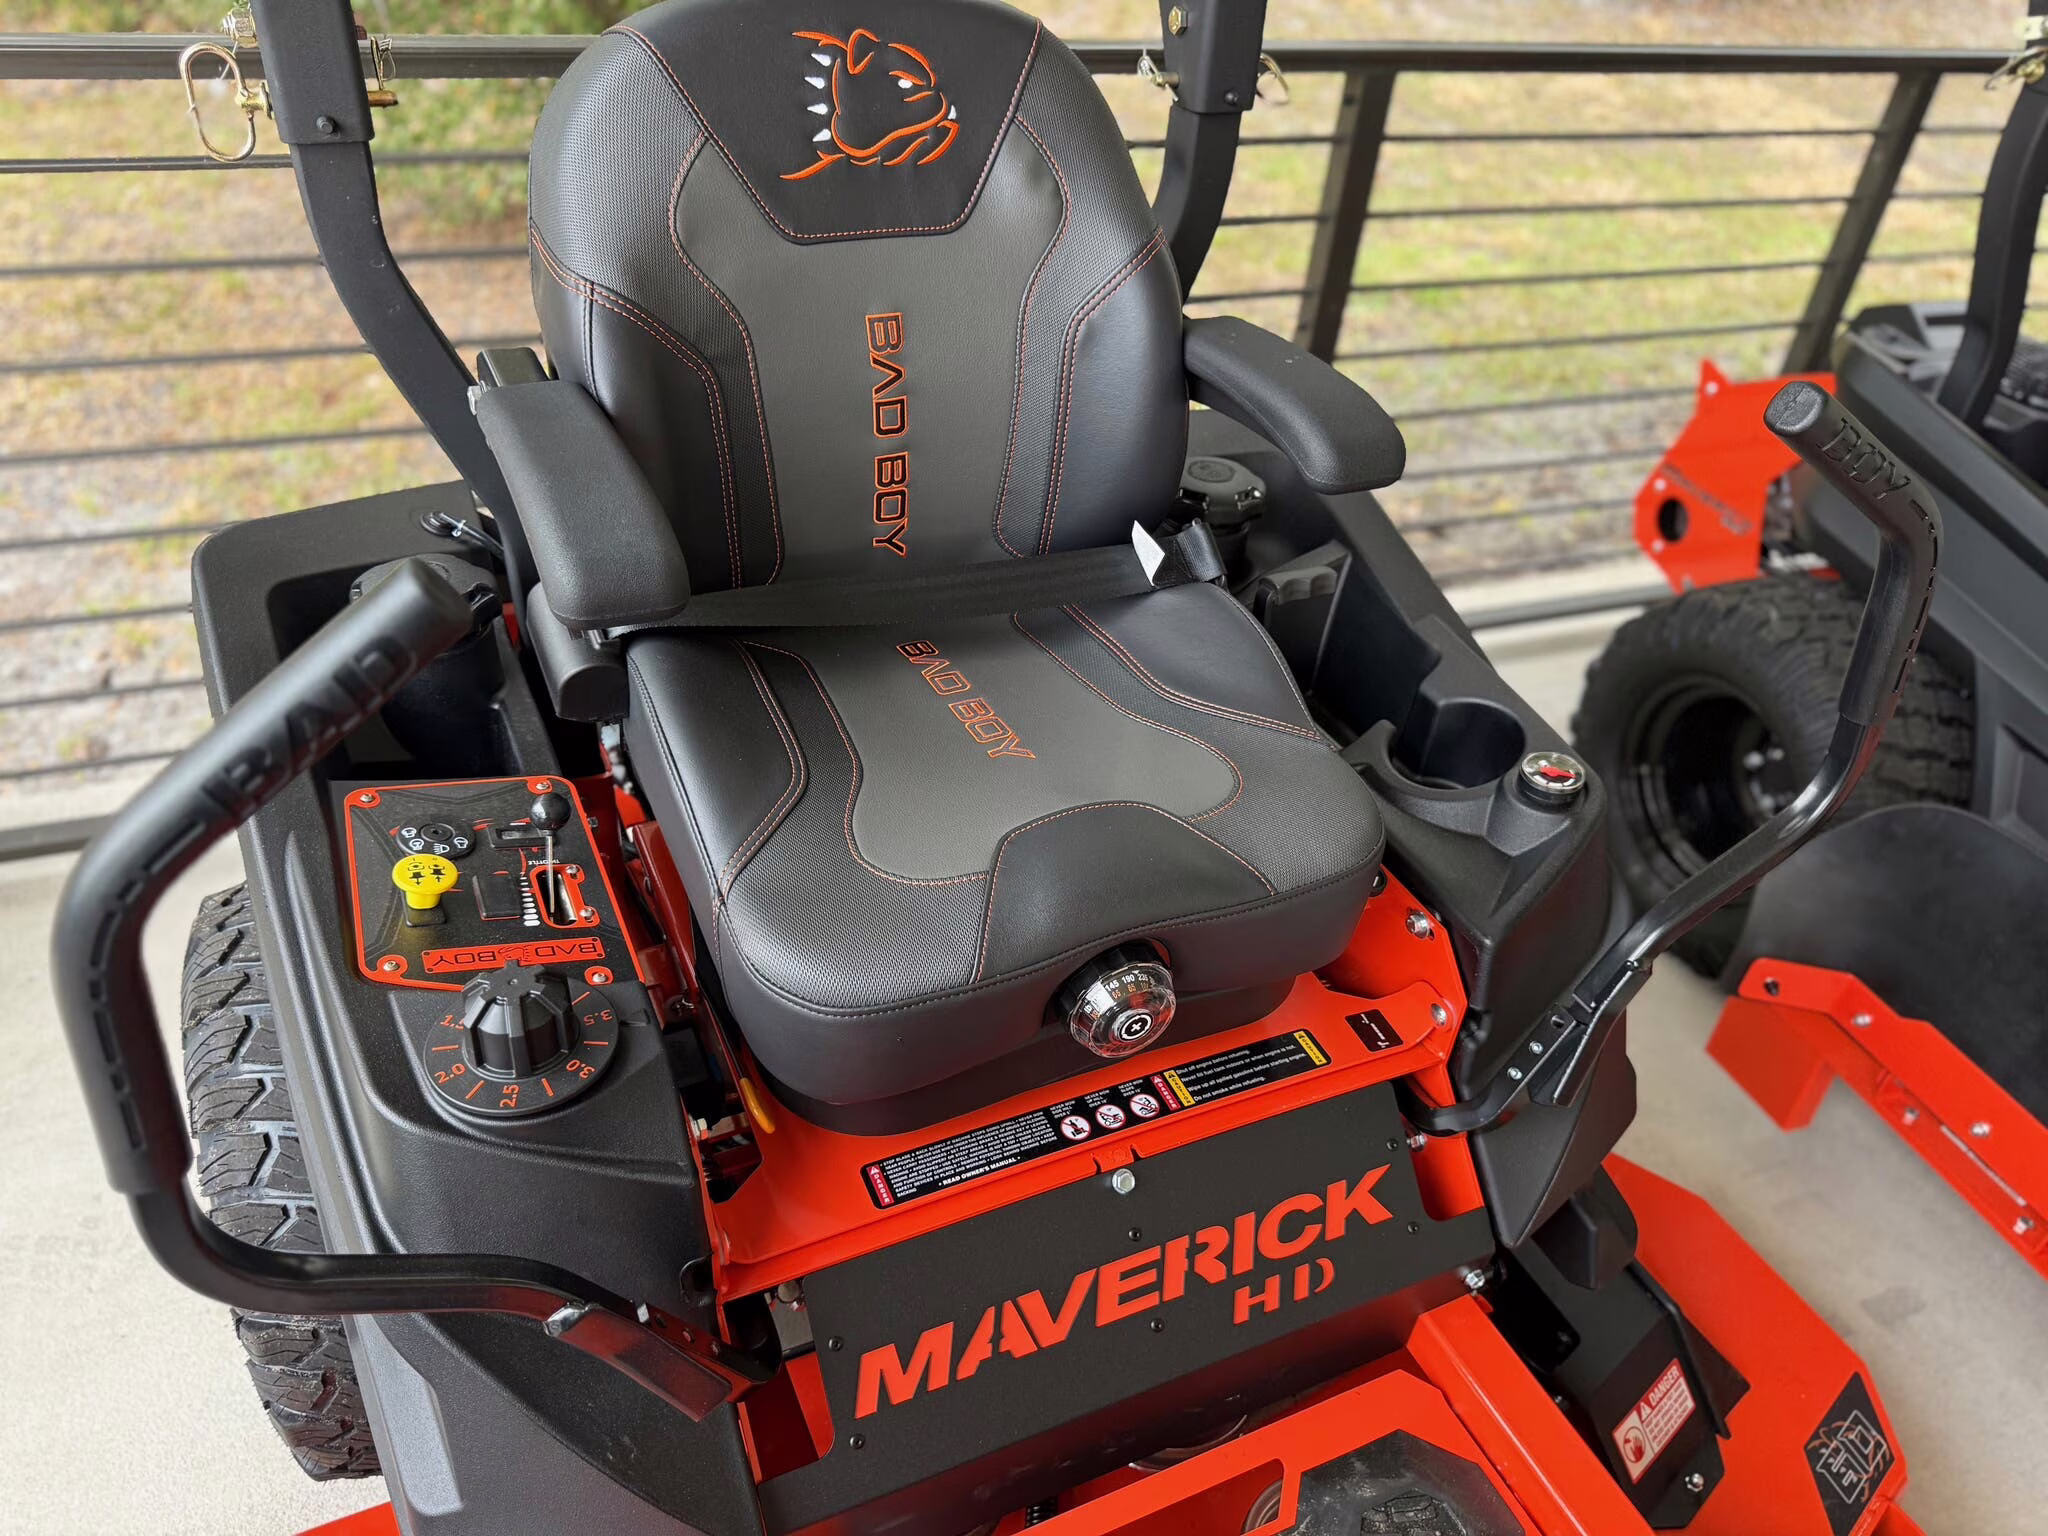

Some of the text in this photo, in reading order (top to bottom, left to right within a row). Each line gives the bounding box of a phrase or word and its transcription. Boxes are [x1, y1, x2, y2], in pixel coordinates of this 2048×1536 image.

[865, 312, 909, 557] BAD BOY
[896, 640, 1035, 760] BAD BOY
[202, 634, 418, 821] BAD
[432, 942, 597, 967] BAD BOY
[1105, 980, 1119, 991] 145
[1122, 974, 1135, 984] 190
[584, 1008, 614, 1026] 3.5
[434, 1063, 466, 1084] 2.0
[566, 1058, 596, 1079] 3.0
[500, 1084, 520, 1108] 2.5
[942, 1158, 1017, 1185] READ OWNER'S MANUAL
[874, 1174, 890, 1203] DANGER
[854, 1163, 1394, 1420] MAVERICK
[1233, 1257, 1335, 1325] HD
[1649, 1365, 1680, 1406] DANGER
